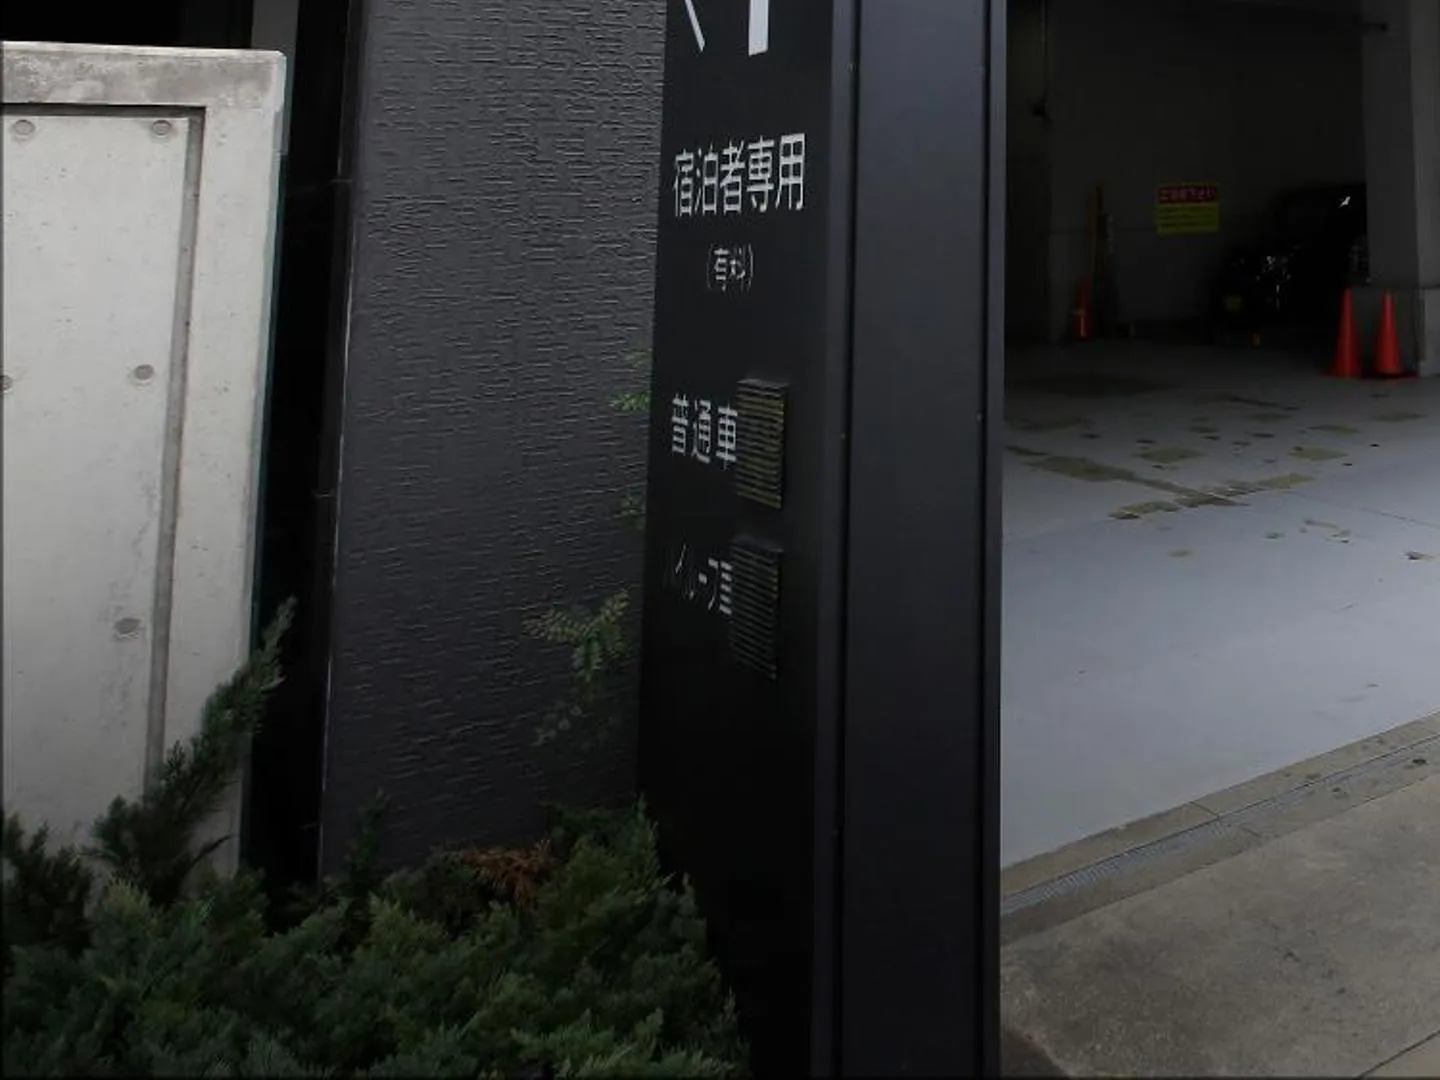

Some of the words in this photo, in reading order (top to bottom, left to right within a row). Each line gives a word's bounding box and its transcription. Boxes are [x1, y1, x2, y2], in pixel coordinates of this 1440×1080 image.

[673, 132, 806, 217] 宿泊者専用
